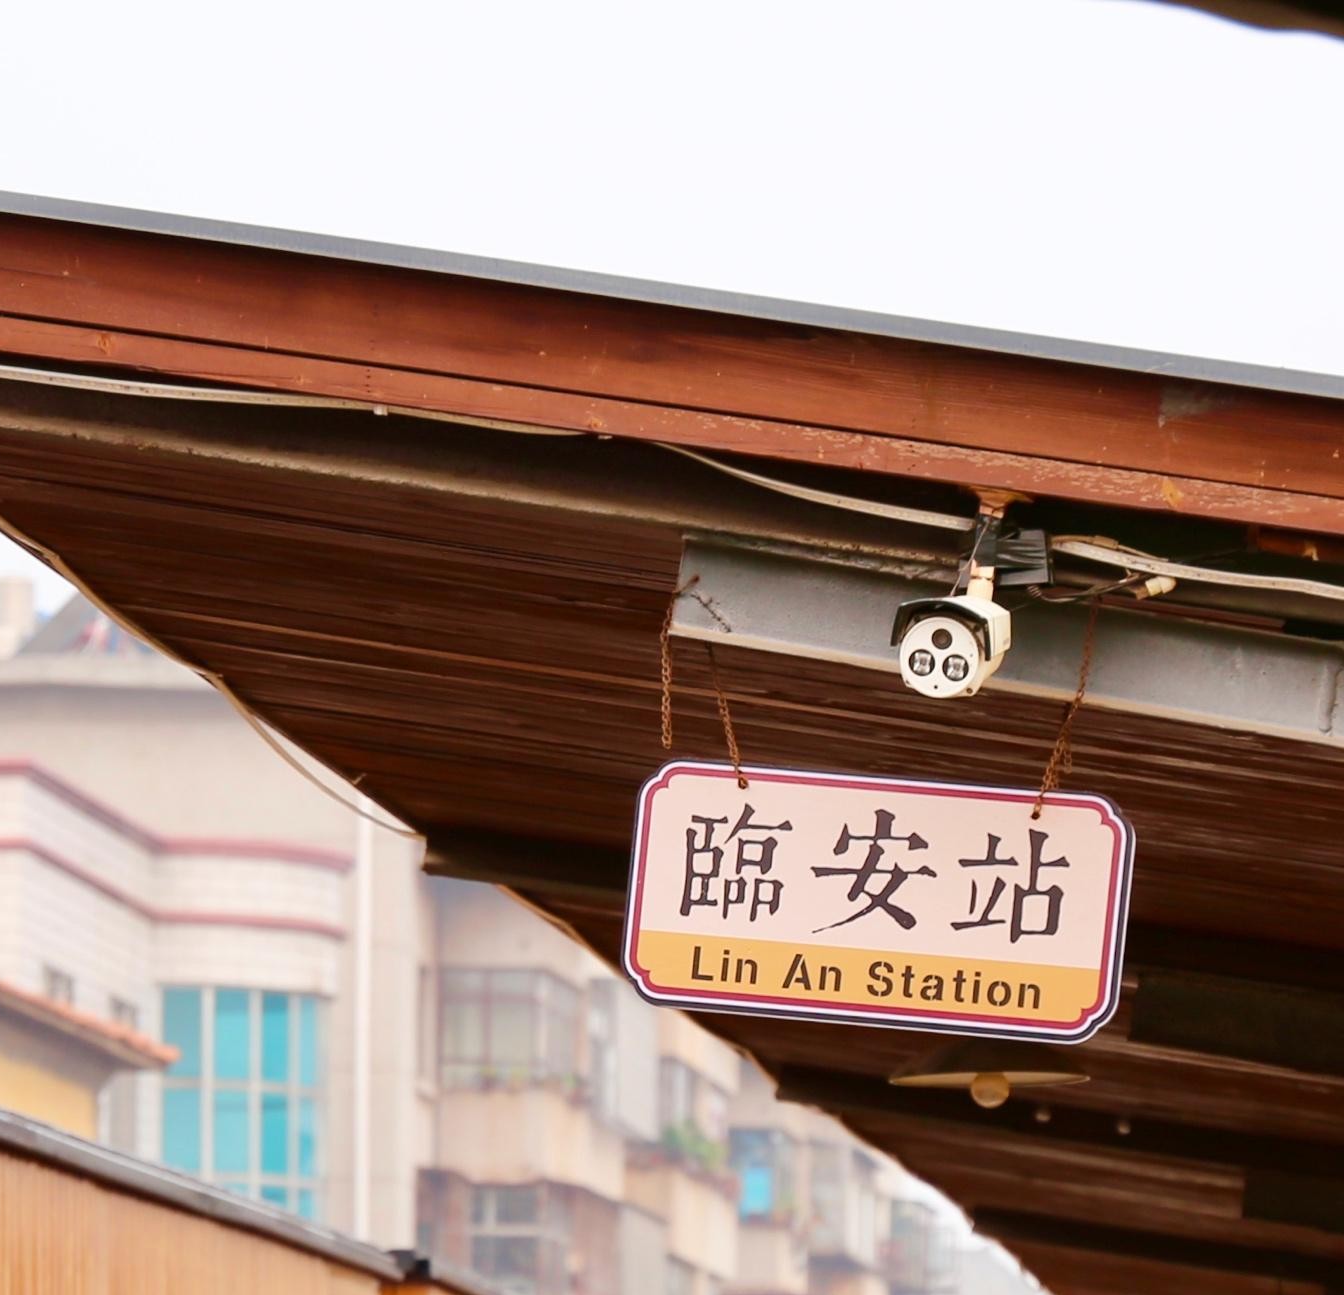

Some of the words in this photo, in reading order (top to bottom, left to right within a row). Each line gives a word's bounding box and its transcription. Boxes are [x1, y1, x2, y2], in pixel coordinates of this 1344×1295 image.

[679, 803, 1070, 944] 臨安站
[690, 945, 758, 986] Lin
[782, 953, 844, 993] An
[866, 960, 1042, 1010] Station
